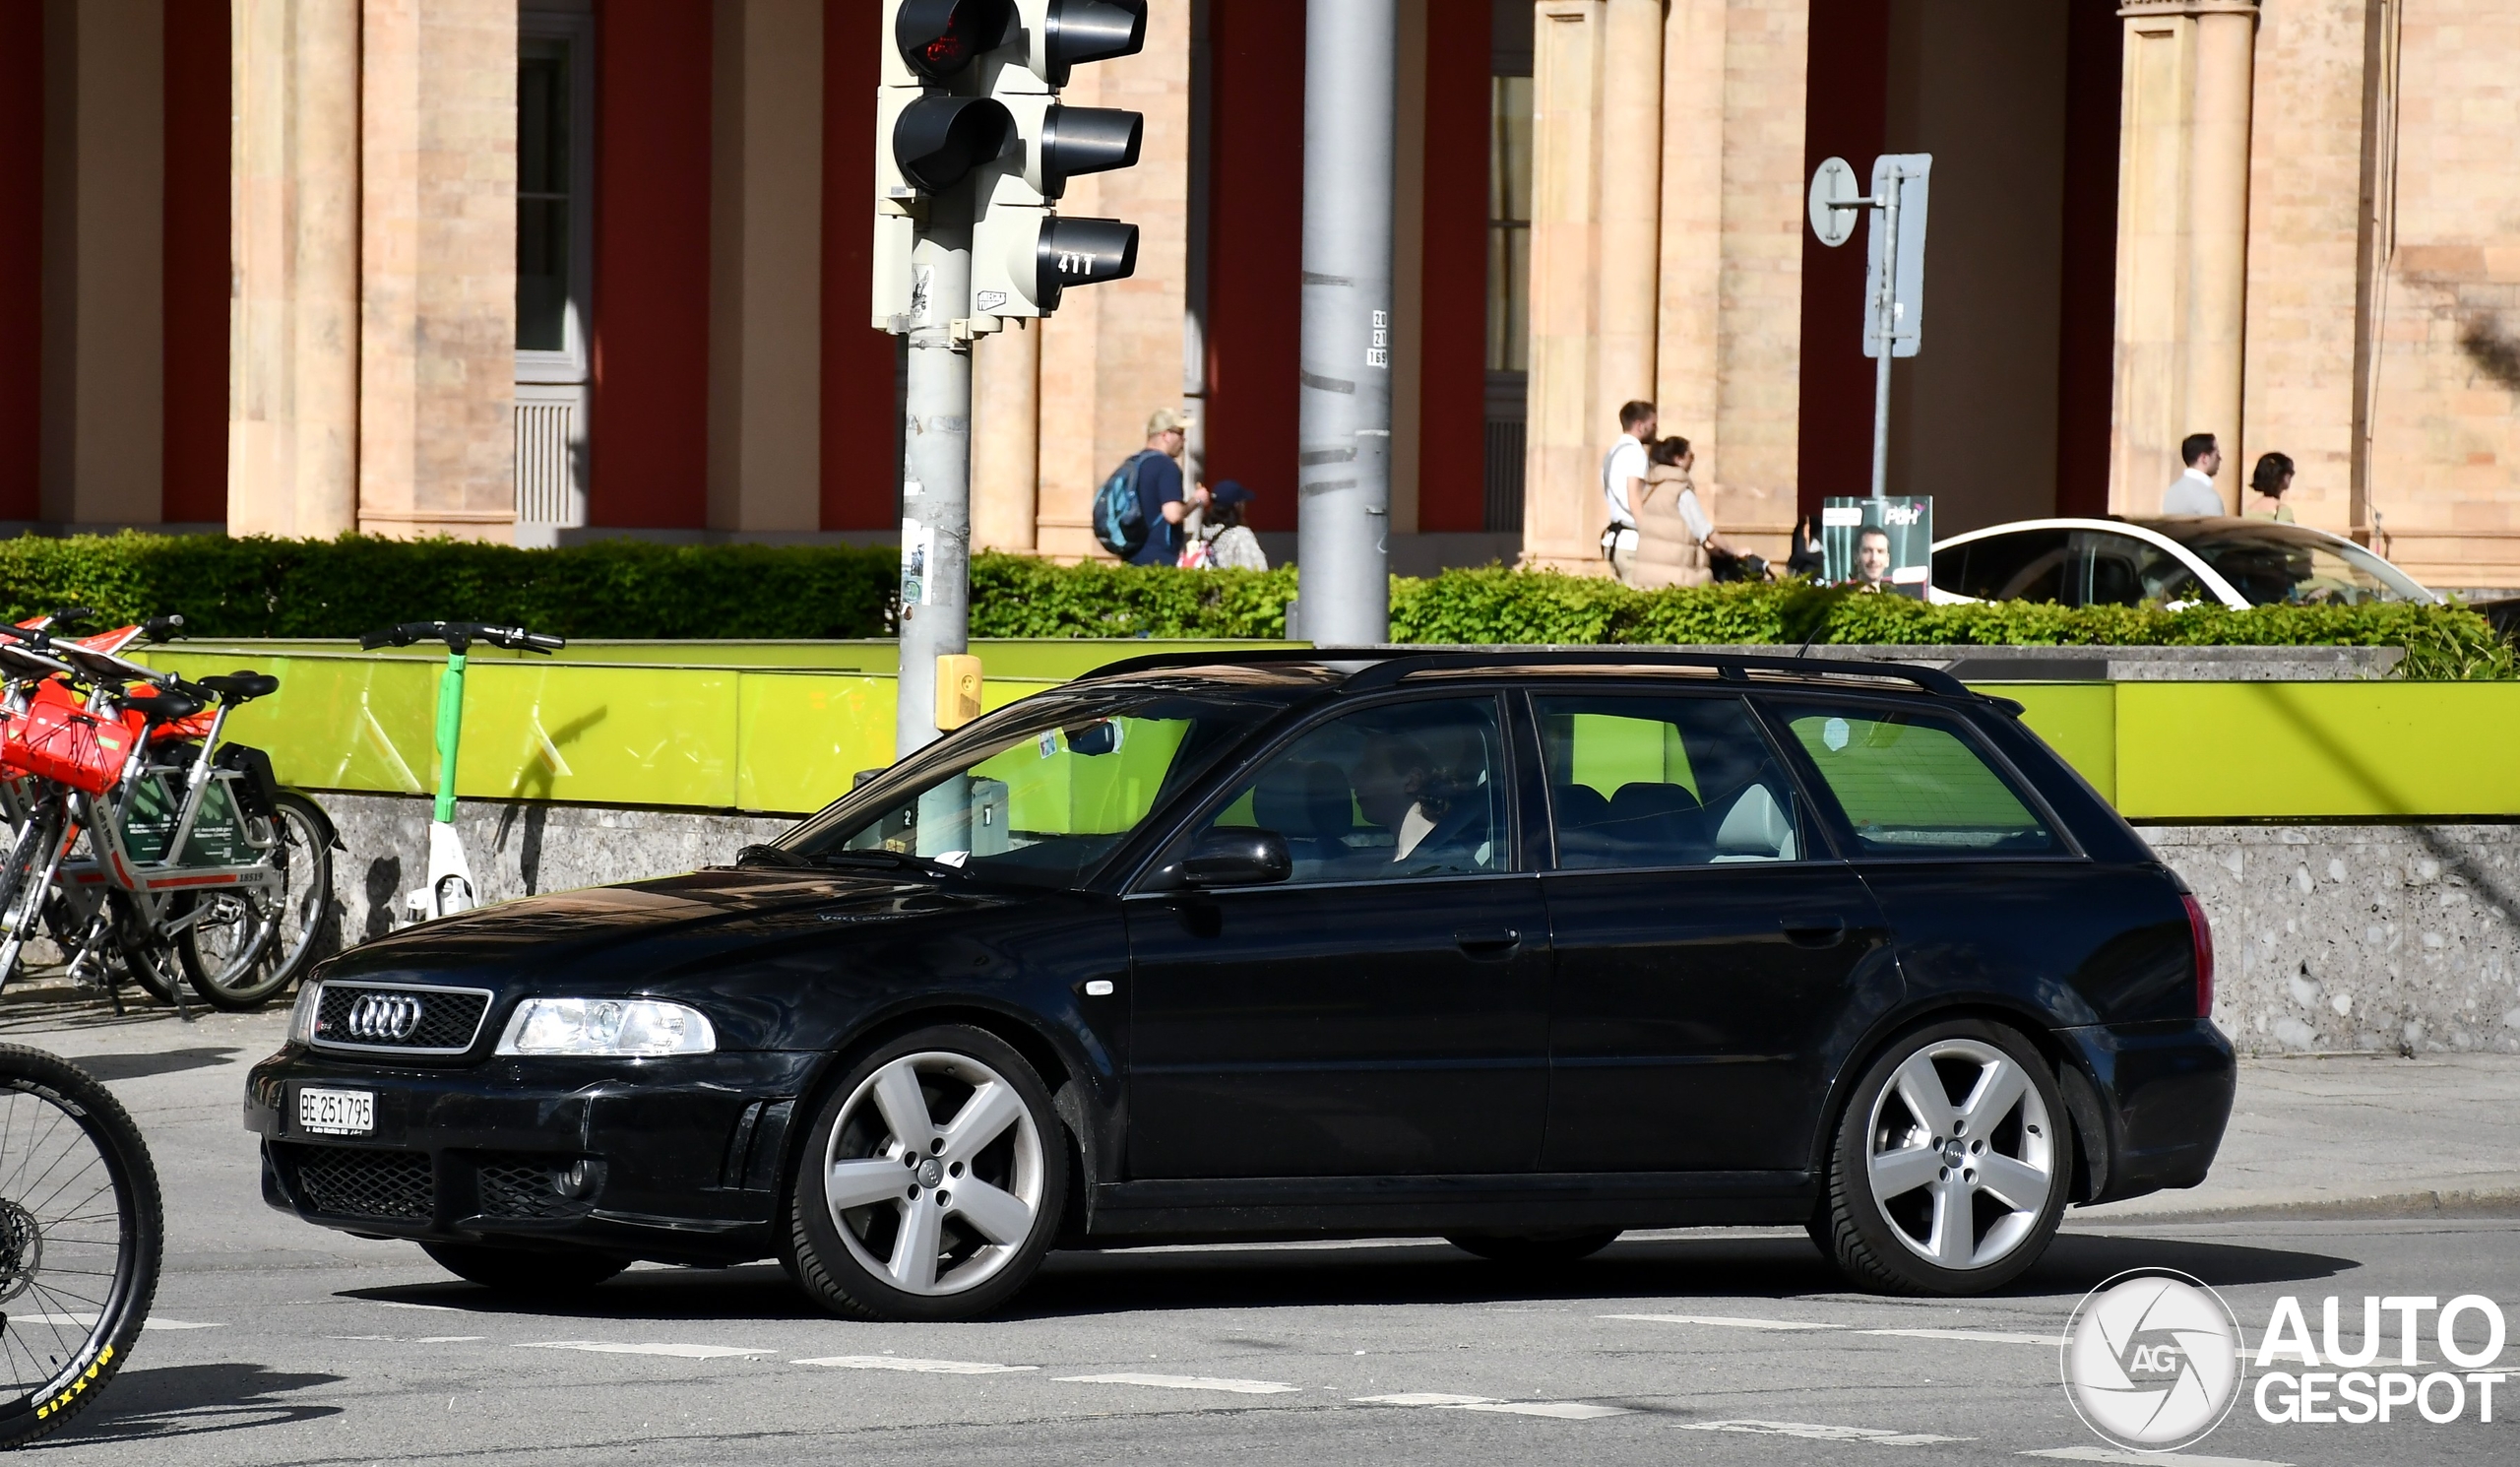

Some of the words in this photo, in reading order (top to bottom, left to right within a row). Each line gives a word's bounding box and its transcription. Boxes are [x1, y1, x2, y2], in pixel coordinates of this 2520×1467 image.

[1375, 333, 1386, 345] 21
[904, 810, 912, 826] 2
[985, 807, 991, 825] 1
[239, 872, 264, 882] 18519
[301, 1094, 317, 1121] BE
[321, 1096, 370, 1125] 251795
[36, 1344, 114, 1420] MAXXIS
